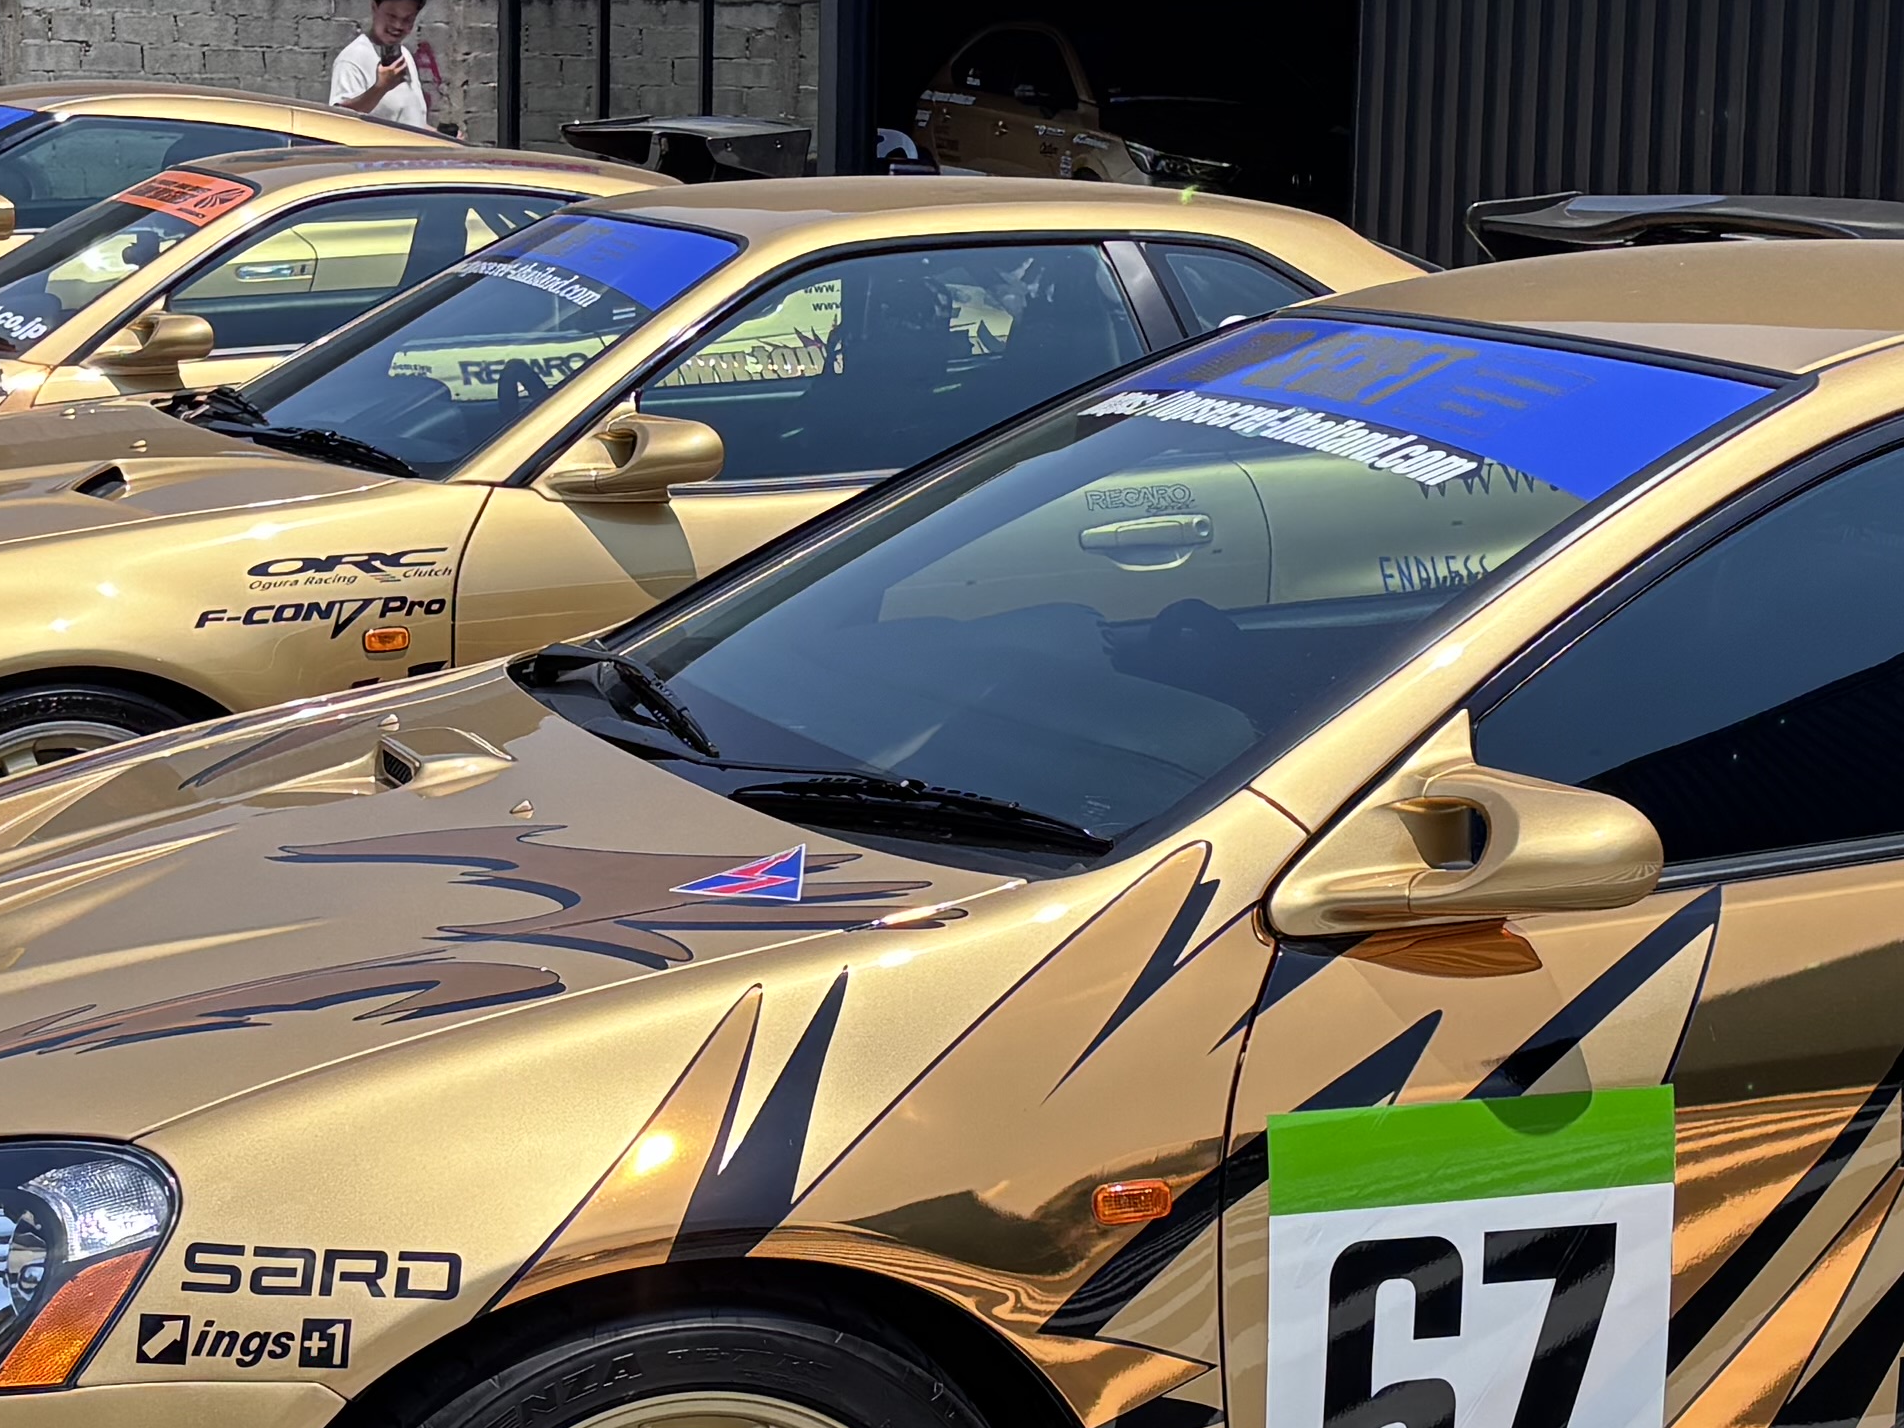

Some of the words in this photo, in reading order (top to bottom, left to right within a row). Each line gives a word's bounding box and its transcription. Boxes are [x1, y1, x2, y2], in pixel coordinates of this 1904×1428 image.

[247, 546, 449, 577] ORC
[248, 576, 299, 592] Ogura
[304, 573, 359, 588] Racing
[402, 567, 453, 579] Clutch
[379, 595, 447, 619] Pro
[191, 1319, 297, 1368] ings
[301, 1320, 351, 1368] +1
